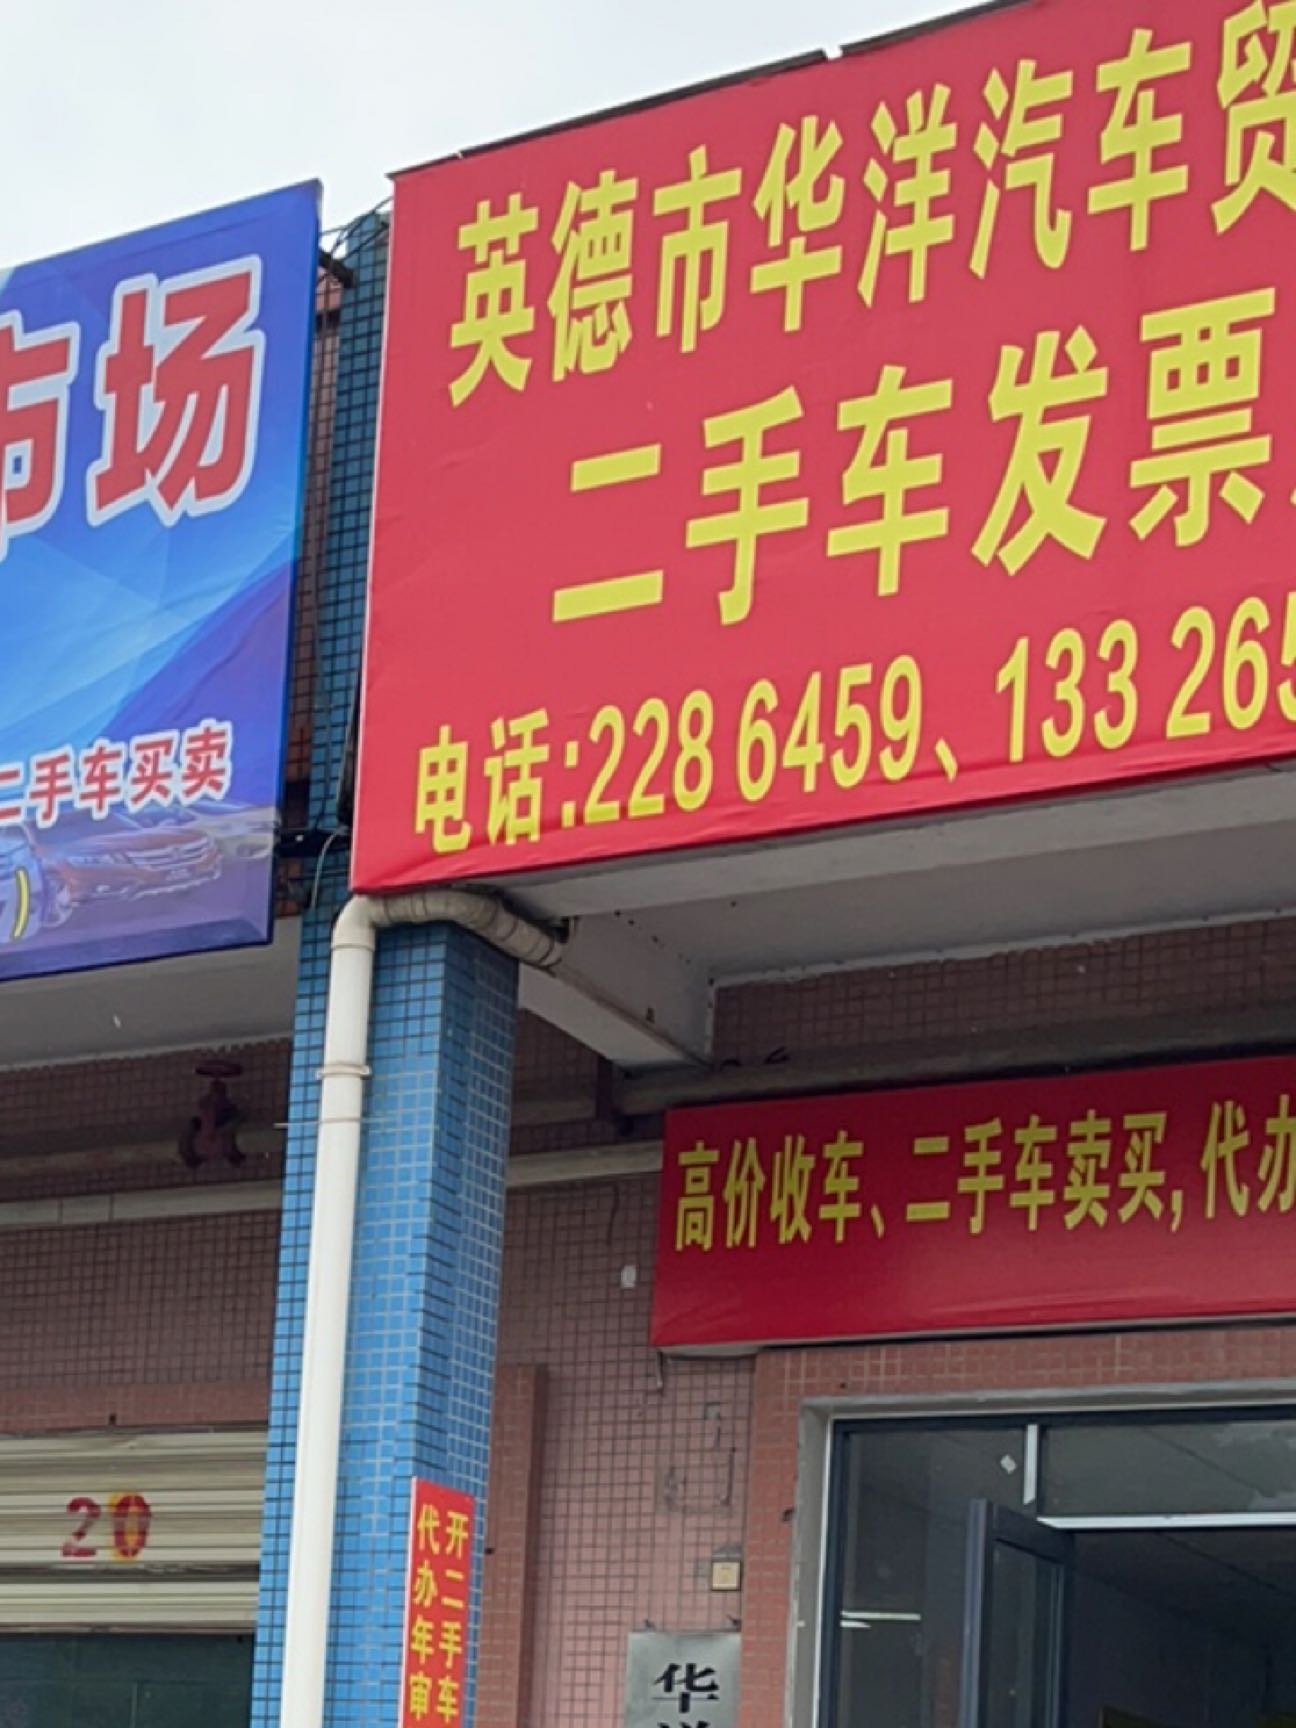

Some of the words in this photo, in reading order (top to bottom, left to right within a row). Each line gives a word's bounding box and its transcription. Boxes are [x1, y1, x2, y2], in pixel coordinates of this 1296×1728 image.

[552, 287, 1296, 625] 二手车发票
[60, 1491, 152, 1562] 20
